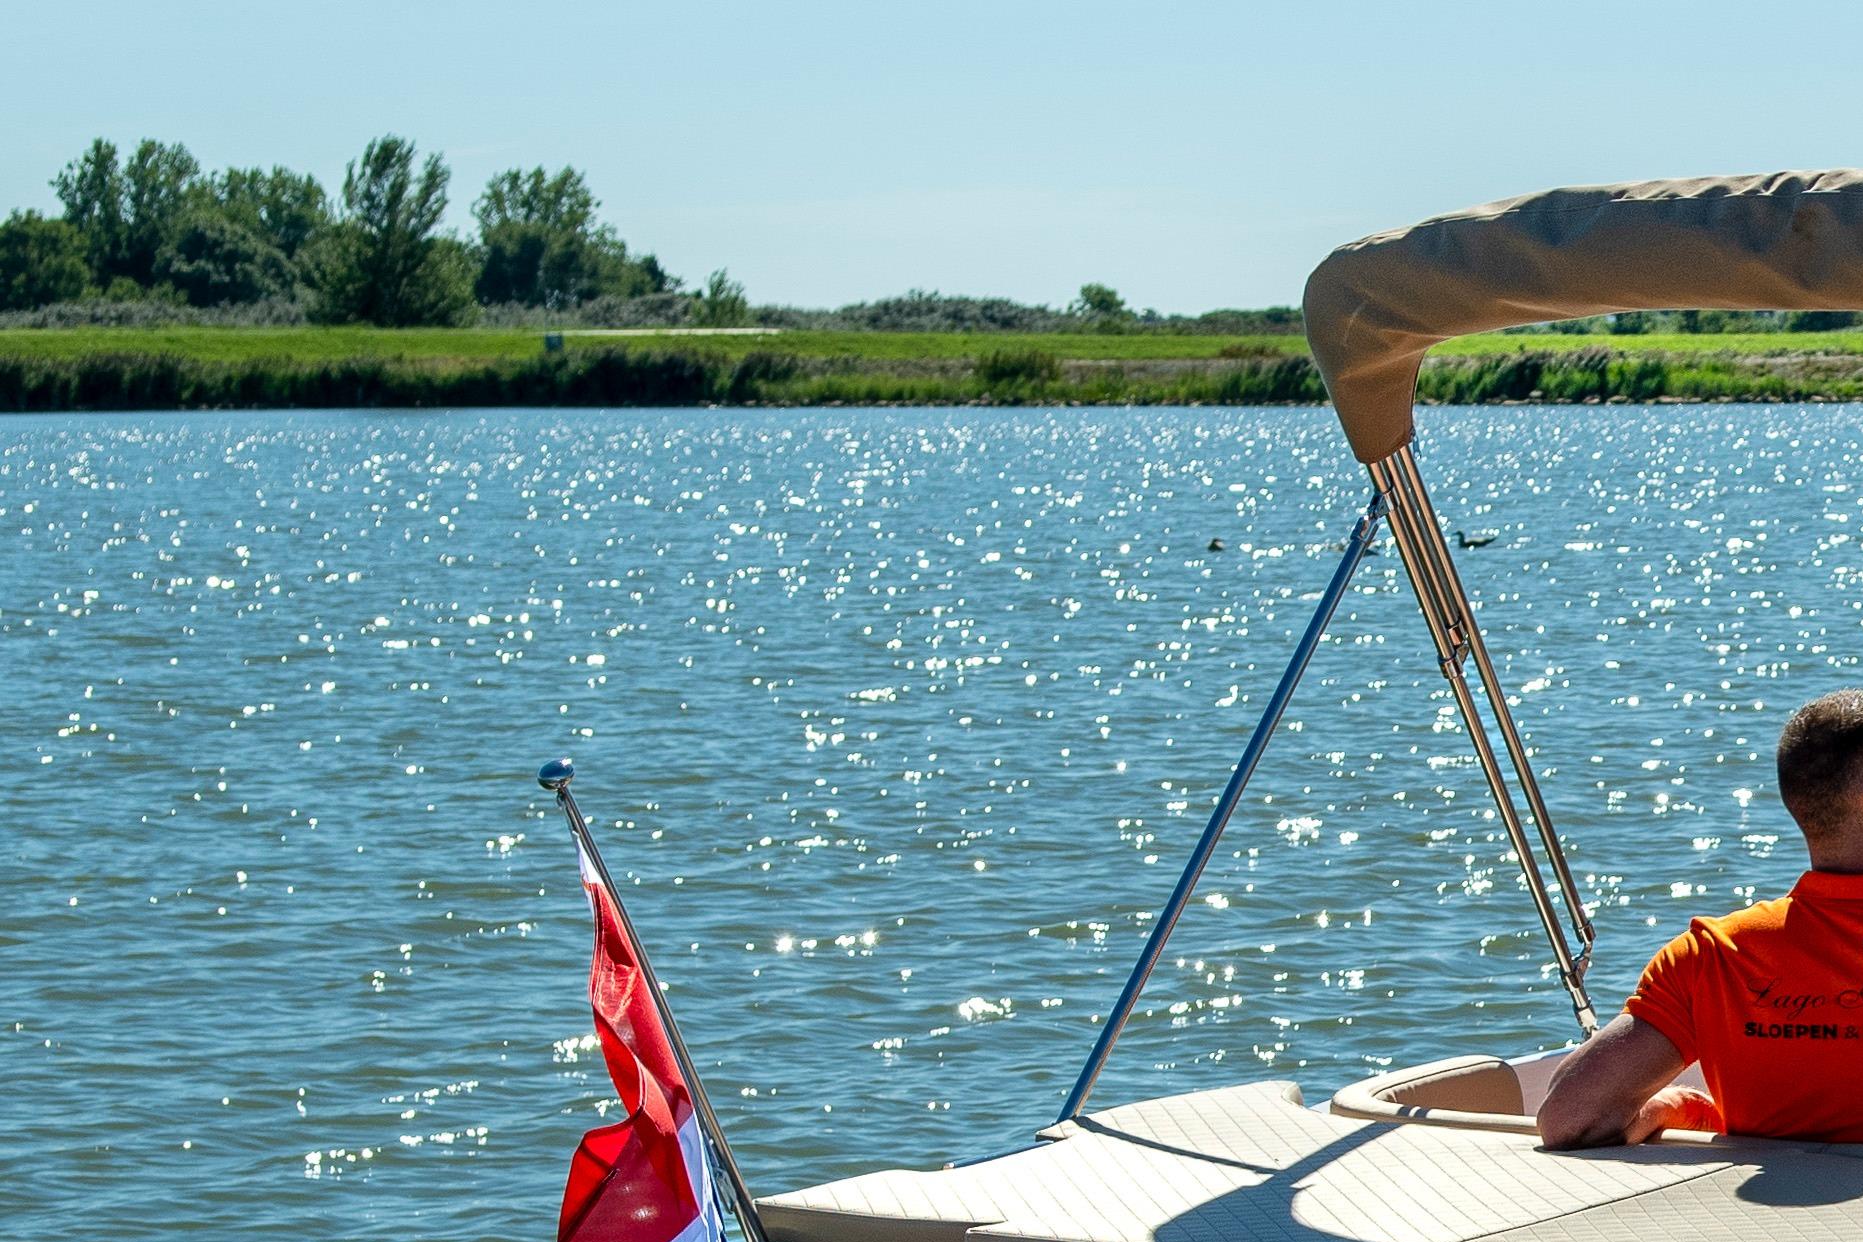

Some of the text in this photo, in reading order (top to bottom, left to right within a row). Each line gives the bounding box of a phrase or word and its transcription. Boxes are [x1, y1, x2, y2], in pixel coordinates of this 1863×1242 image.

[1745, 976, 1827, 1019] Lago
[1744, 1022, 1838, 1040] SLOEPEN
[1844, 1025, 1860, 1040] &
